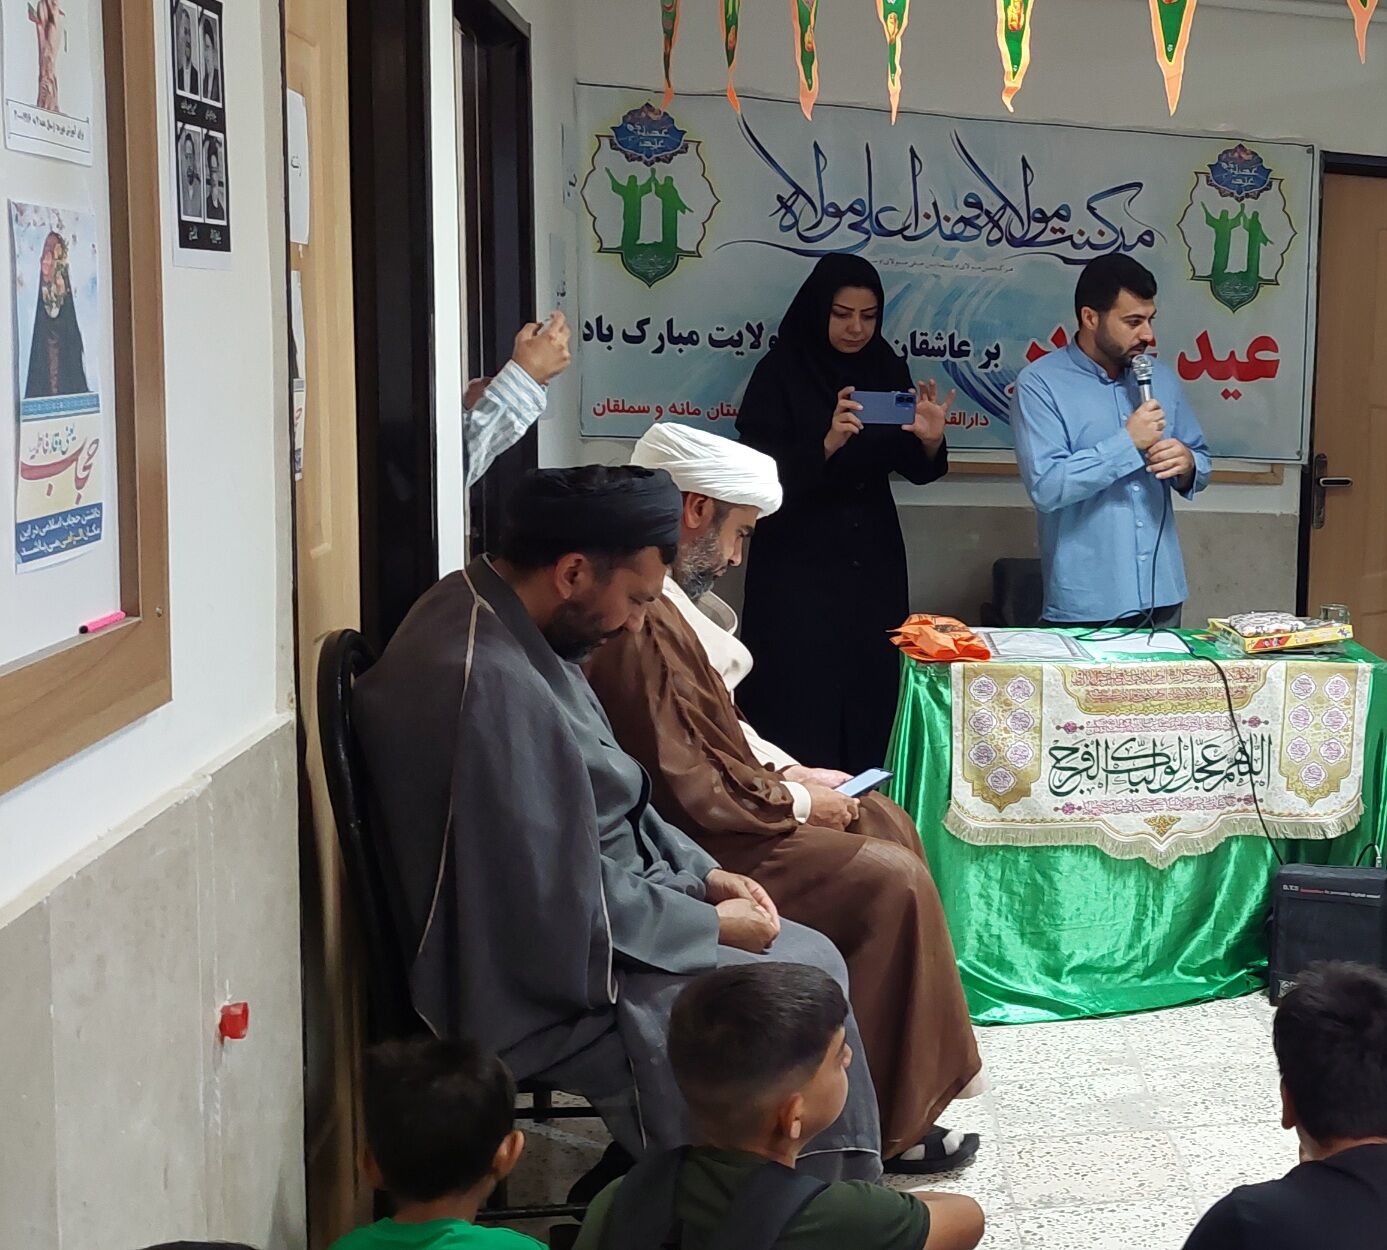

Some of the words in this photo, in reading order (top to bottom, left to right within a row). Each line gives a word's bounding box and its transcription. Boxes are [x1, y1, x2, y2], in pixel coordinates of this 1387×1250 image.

[582, 314, 614, 351] باد
[622, 316, 700, 354] مبارک
[894, 330, 971, 359] عاشقان
[978, 342, 1001, 369] بر
[1178, 330, 1280, 400] عید
[593, 397, 651, 417] سملقان
[654, 404, 664, 420] و
[668, 400, 702, 417] مانه
